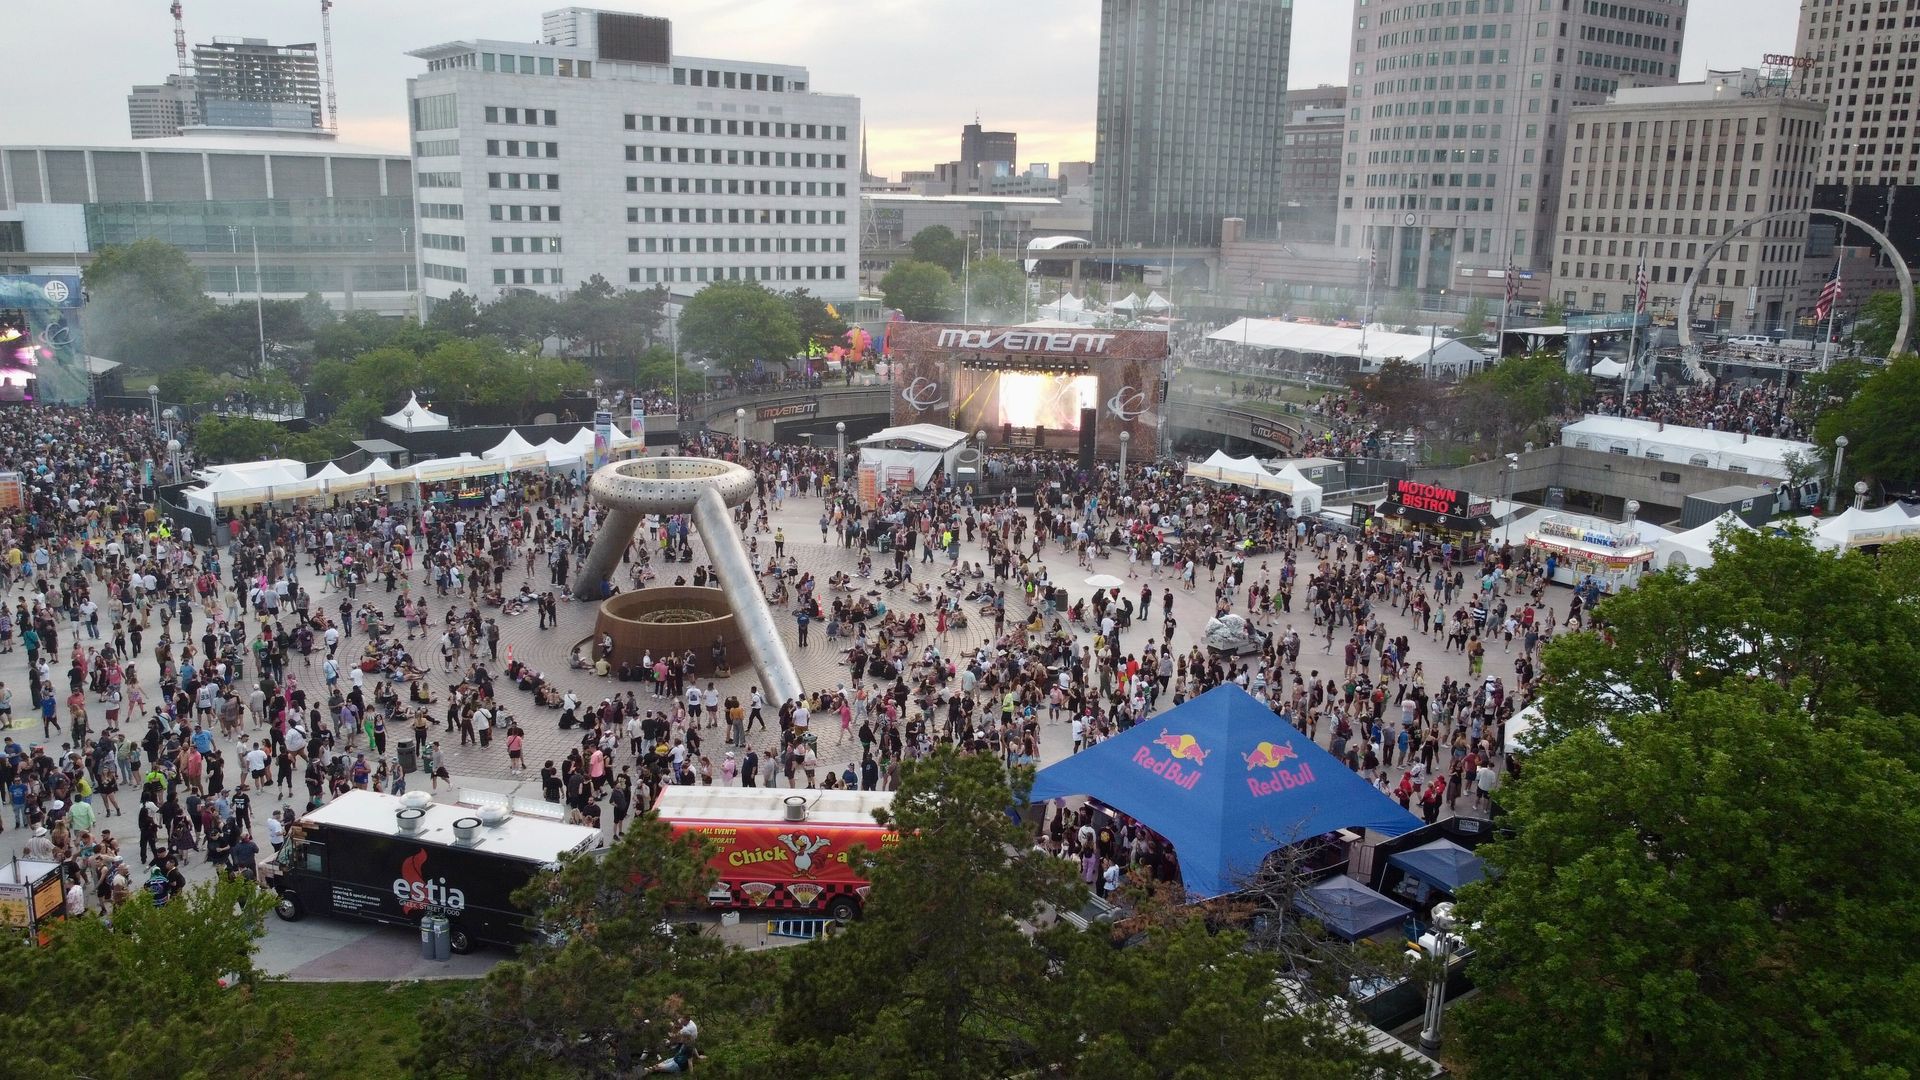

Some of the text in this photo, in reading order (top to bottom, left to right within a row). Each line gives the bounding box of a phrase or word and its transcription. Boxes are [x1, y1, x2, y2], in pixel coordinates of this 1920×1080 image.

[1762, 54, 1816, 68] SCIENTOLOGY
[1398, 480, 1457, 502] MOTOWN
[1402, 493, 1449, 513] BISTRO
[1469, 504, 1491, 518] Bistro
[1583, 535, 1617, 548] DRINKS
[1132, 746, 1202, 790] Red Bull
[1247, 762, 1315, 797] Red Bull
[714, 828, 736, 836] EVENTS
[881, 833, 900, 842] CALL
[728, 846, 788, 867] Chick
[393, 877, 465, 910] estia
[419, 904, 441, 913] STREET
[443, 907, 460, 916] FOOD
